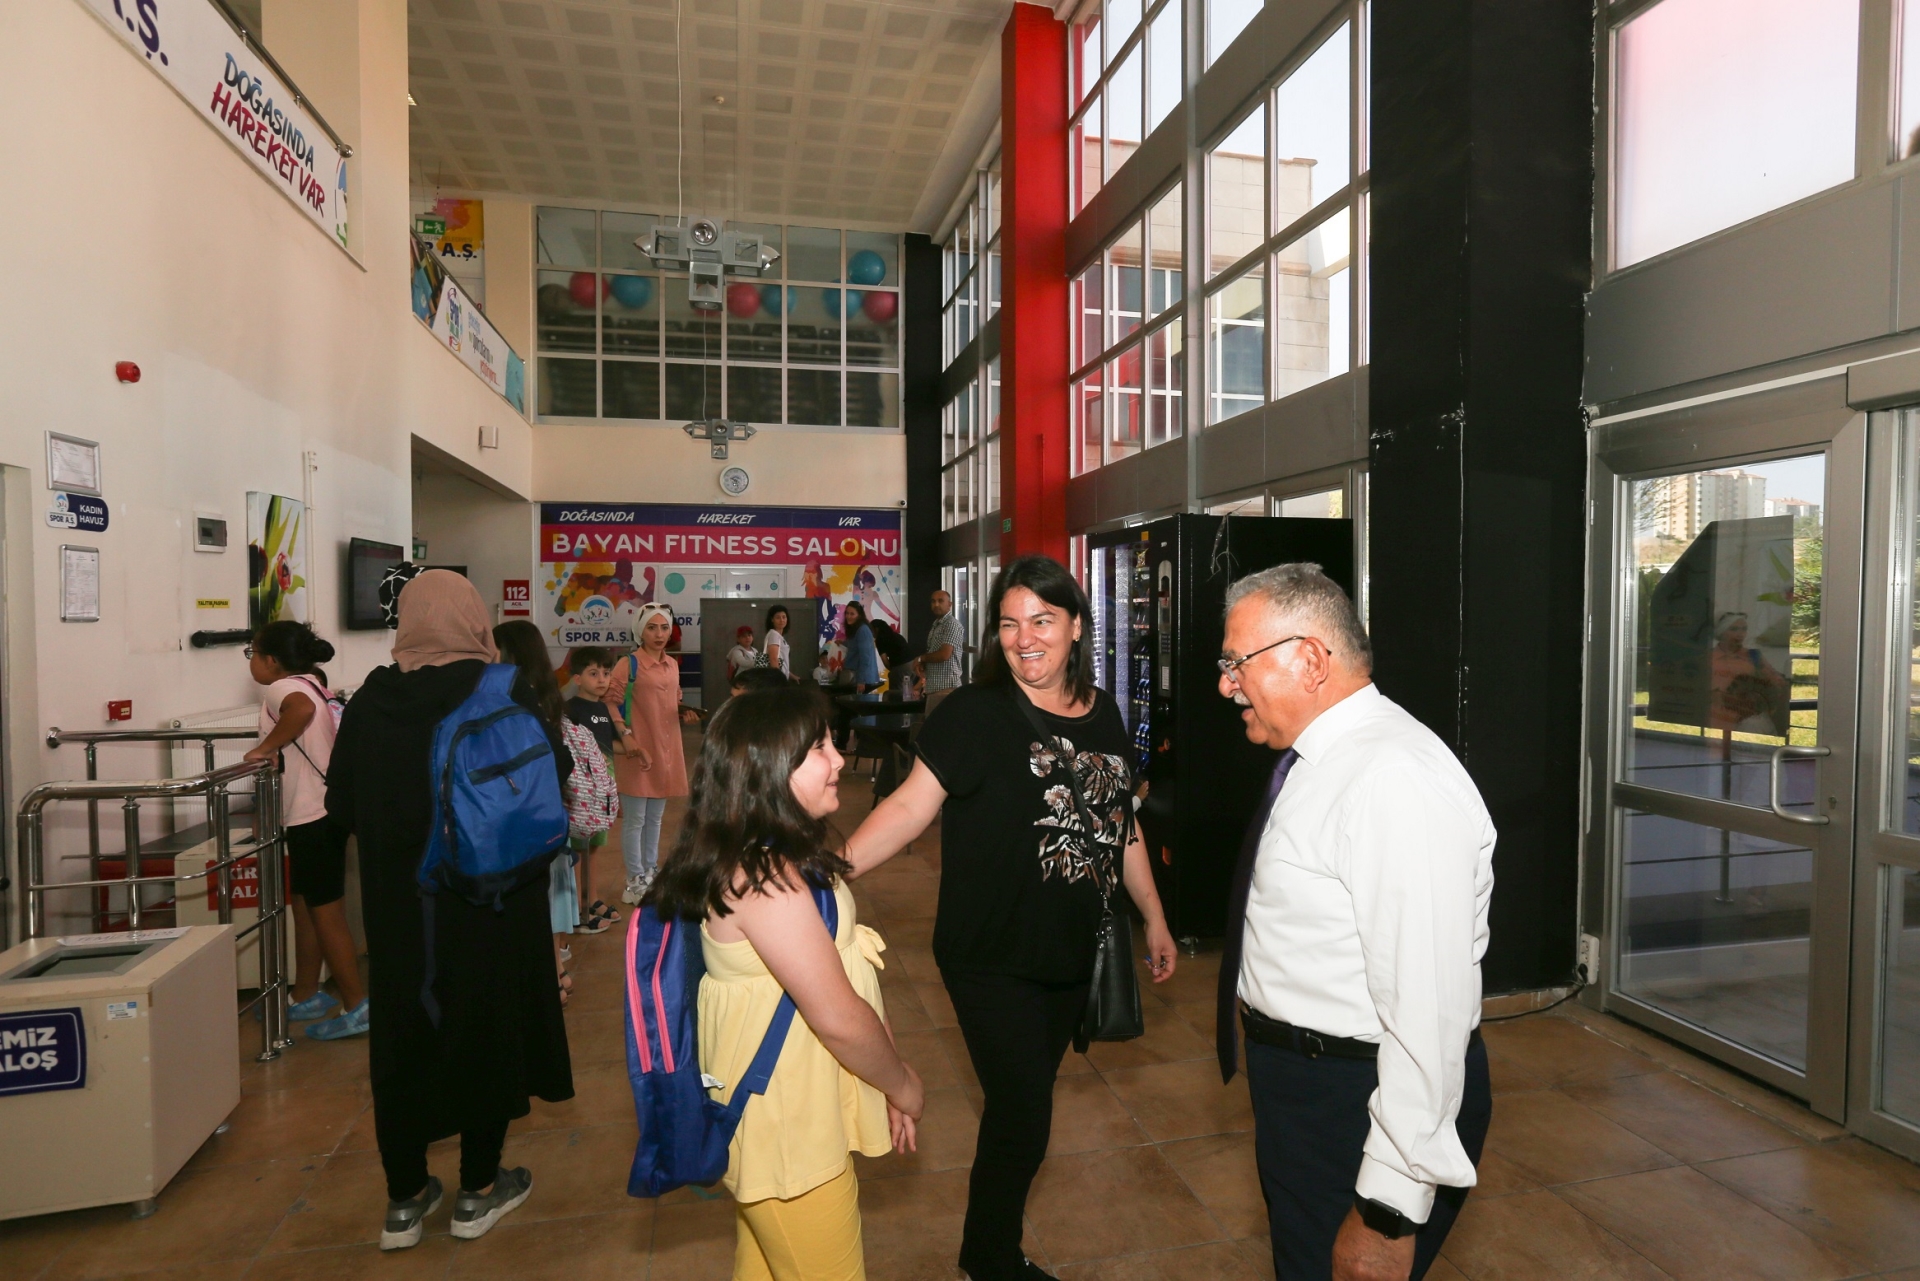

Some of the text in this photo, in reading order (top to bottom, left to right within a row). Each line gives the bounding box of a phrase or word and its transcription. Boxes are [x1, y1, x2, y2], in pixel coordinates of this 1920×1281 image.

[224, 52, 315, 172] DOĞASINDA
[211, 82, 326, 218] HAREKET VAR
[441, 242, 478, 262] A.Ş.
[79, 504, 103, 515] KADIN
[49, 514, 64, 523] SPOR
[79, 514, 104, 526] HAVUZ
[559, 509, 862, 527] DOĞASINDA HAREKET VAR
[552, 533, 898, 557] BAYAN FITNESS SALONU
[506, 586, 527, 599] 112
[565, 631, 630, 644] SPOR A.Ş.
